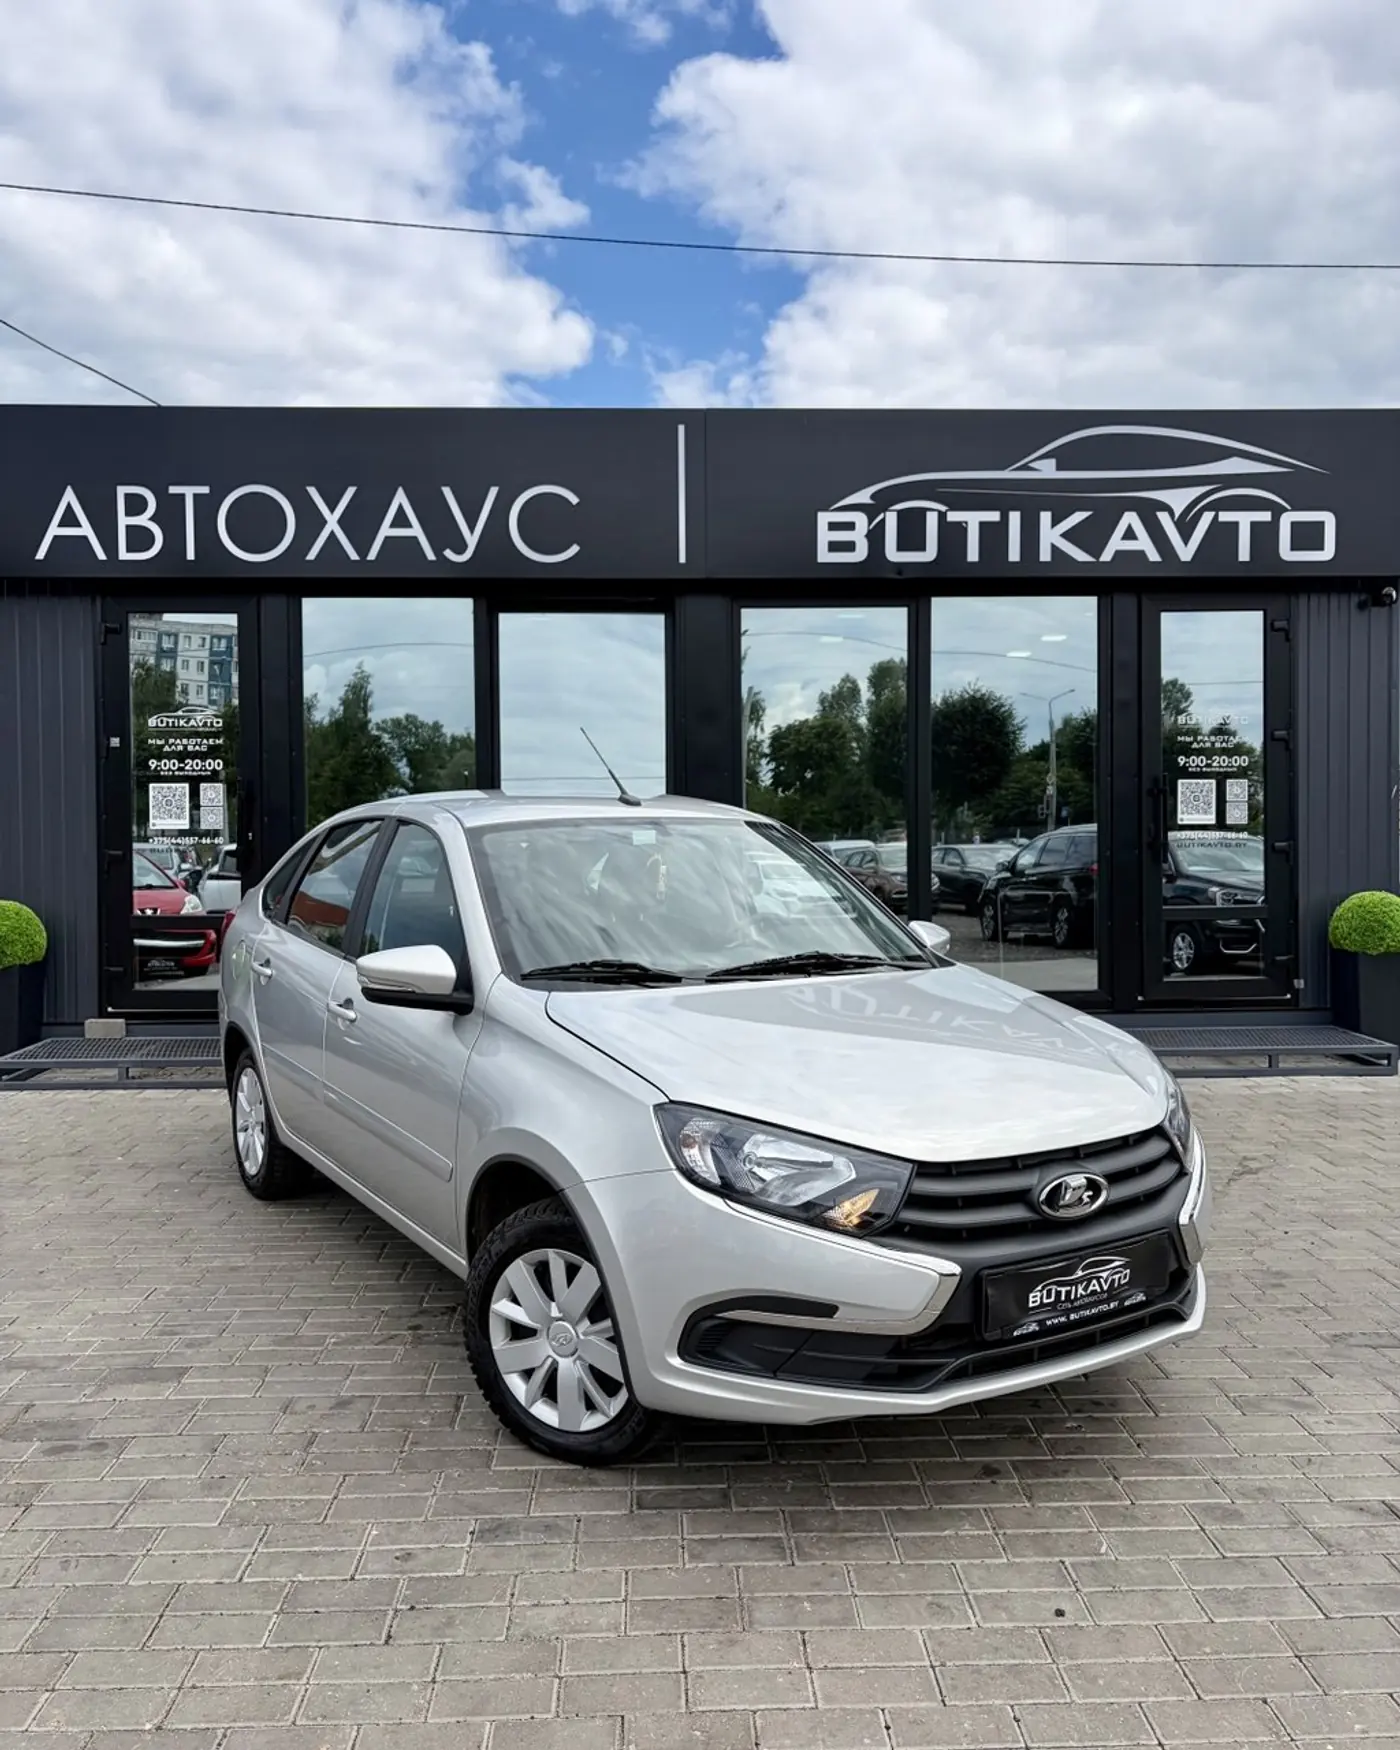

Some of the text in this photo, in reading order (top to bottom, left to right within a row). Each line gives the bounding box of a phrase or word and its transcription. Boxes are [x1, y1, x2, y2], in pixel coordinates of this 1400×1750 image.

[34, 484, 581, 564] АВТОХАУС
[816, 510, 1337, 563] BUTIKAVTO
[147, 717, 223, 727] BUTIKAVTO
[148, 758, 223, 770] 9:00-20:00
[1177, 756, 1249, 767] 9:00-20:00
[1028, 1268, 1131, 1308] BUTIKAVTO
